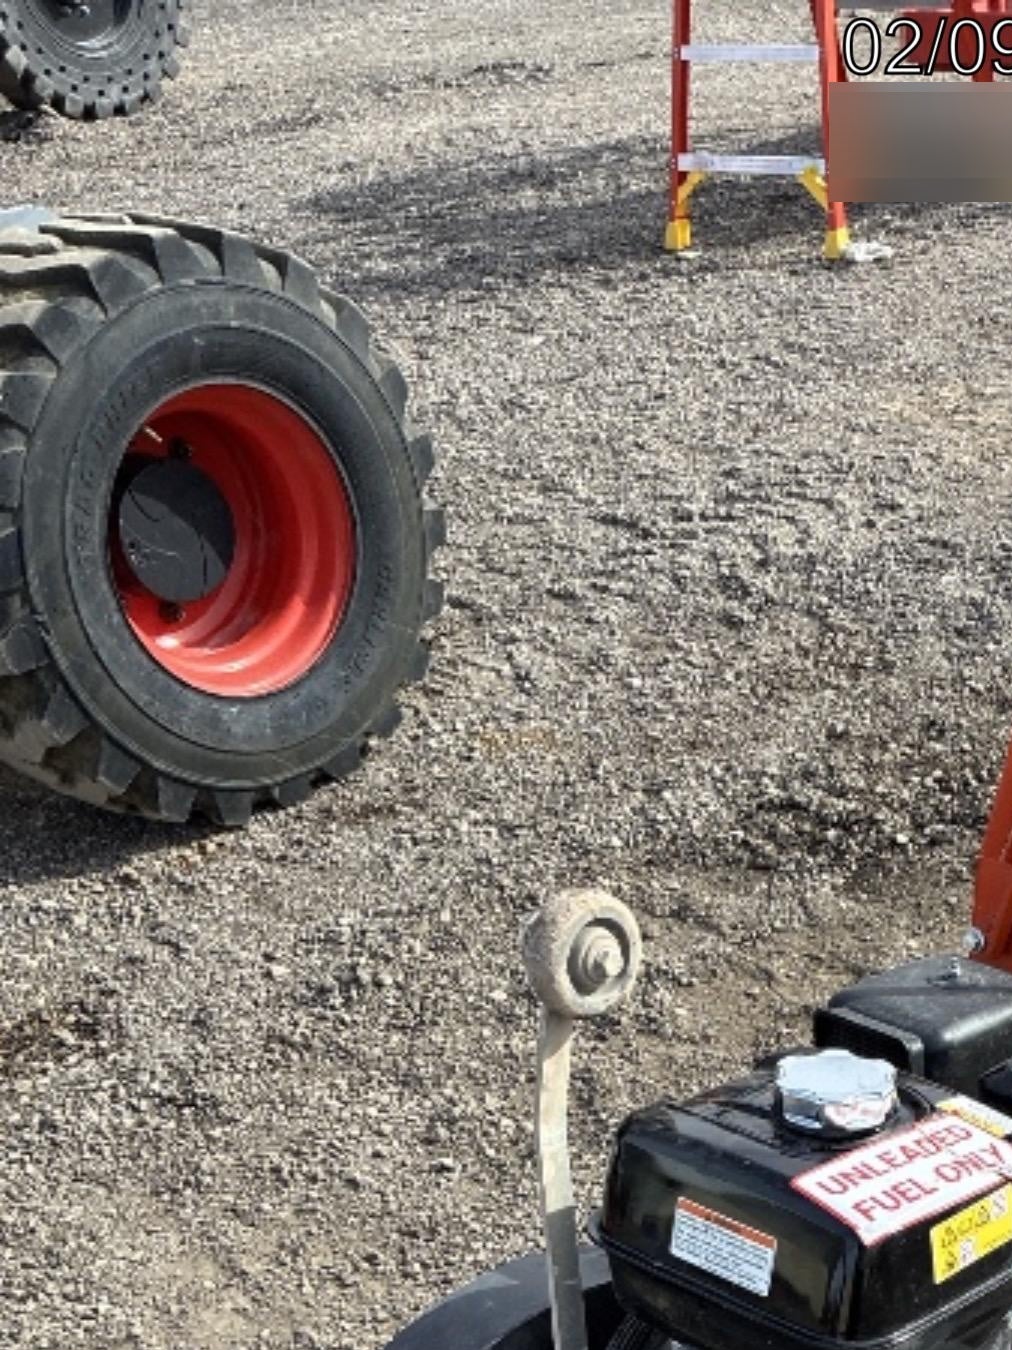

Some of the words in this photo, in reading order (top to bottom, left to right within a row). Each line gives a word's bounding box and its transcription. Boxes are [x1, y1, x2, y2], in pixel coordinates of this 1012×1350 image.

[815, 1124, 974, 1196] UNLEADED
[851, 1178, 939, 1223] FUEL
[933, 1142, 1007, 1184] ONLY
